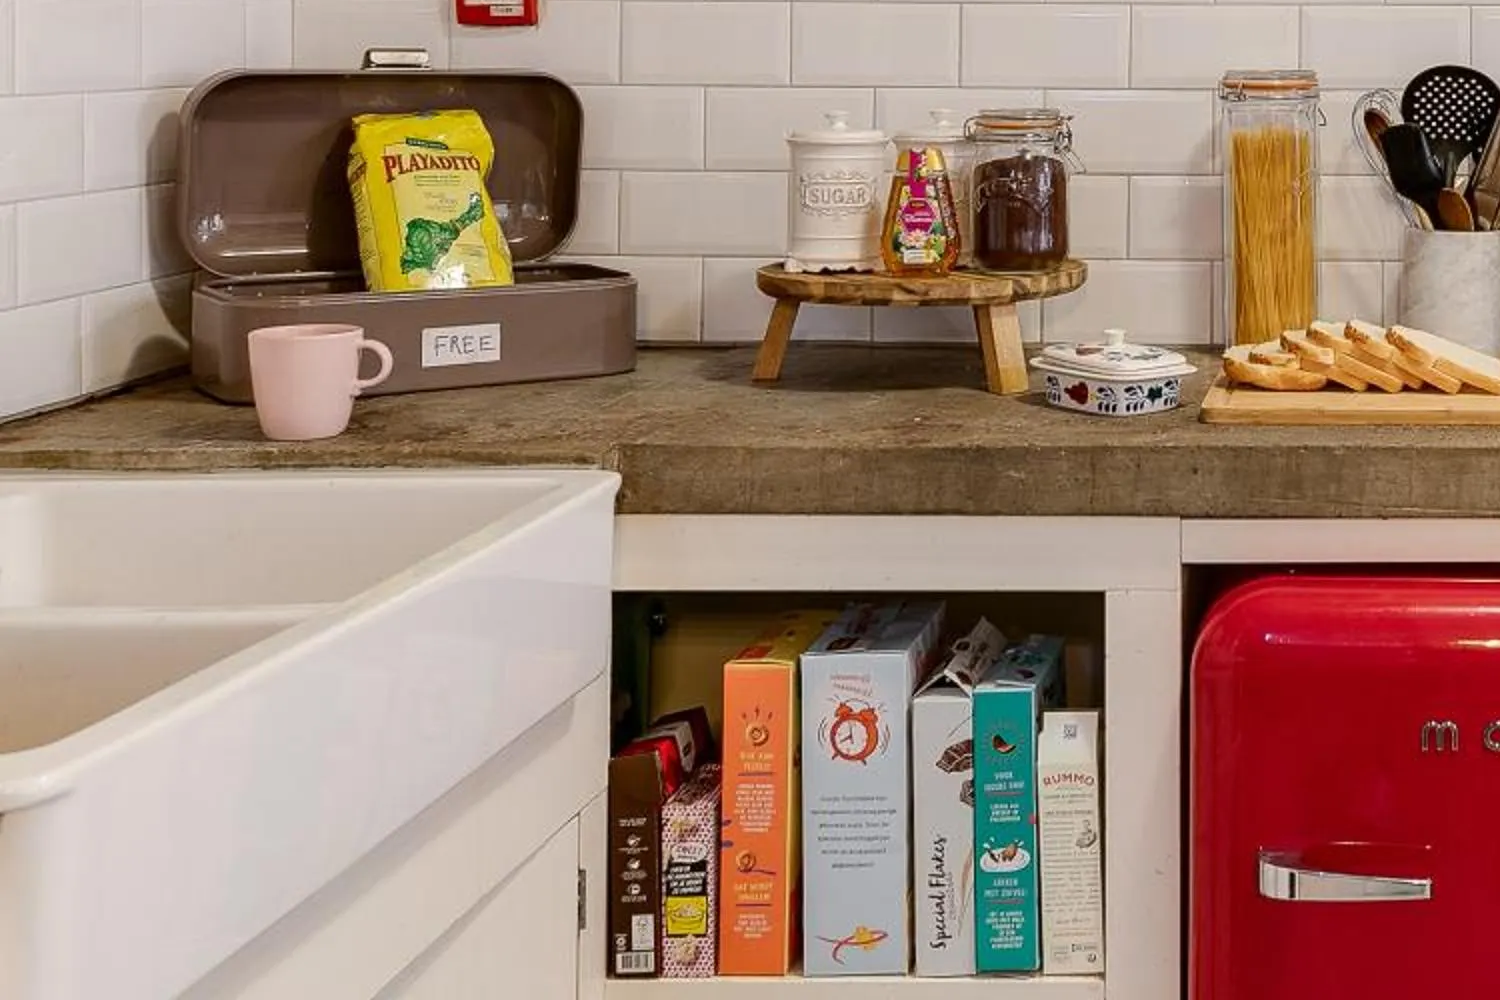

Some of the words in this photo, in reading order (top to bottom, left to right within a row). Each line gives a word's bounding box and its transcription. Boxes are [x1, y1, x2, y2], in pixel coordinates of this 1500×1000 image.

[382, 152, 481, 183] PLAYADITO
[809, 187, 868, 204] SUGAR
[434, 334, 497, 357] FREE
[1043, 772, 1095, 786] RUMMO
[927, 835, 947, 887] Flakes
[927, 891, 953, 949] Special
